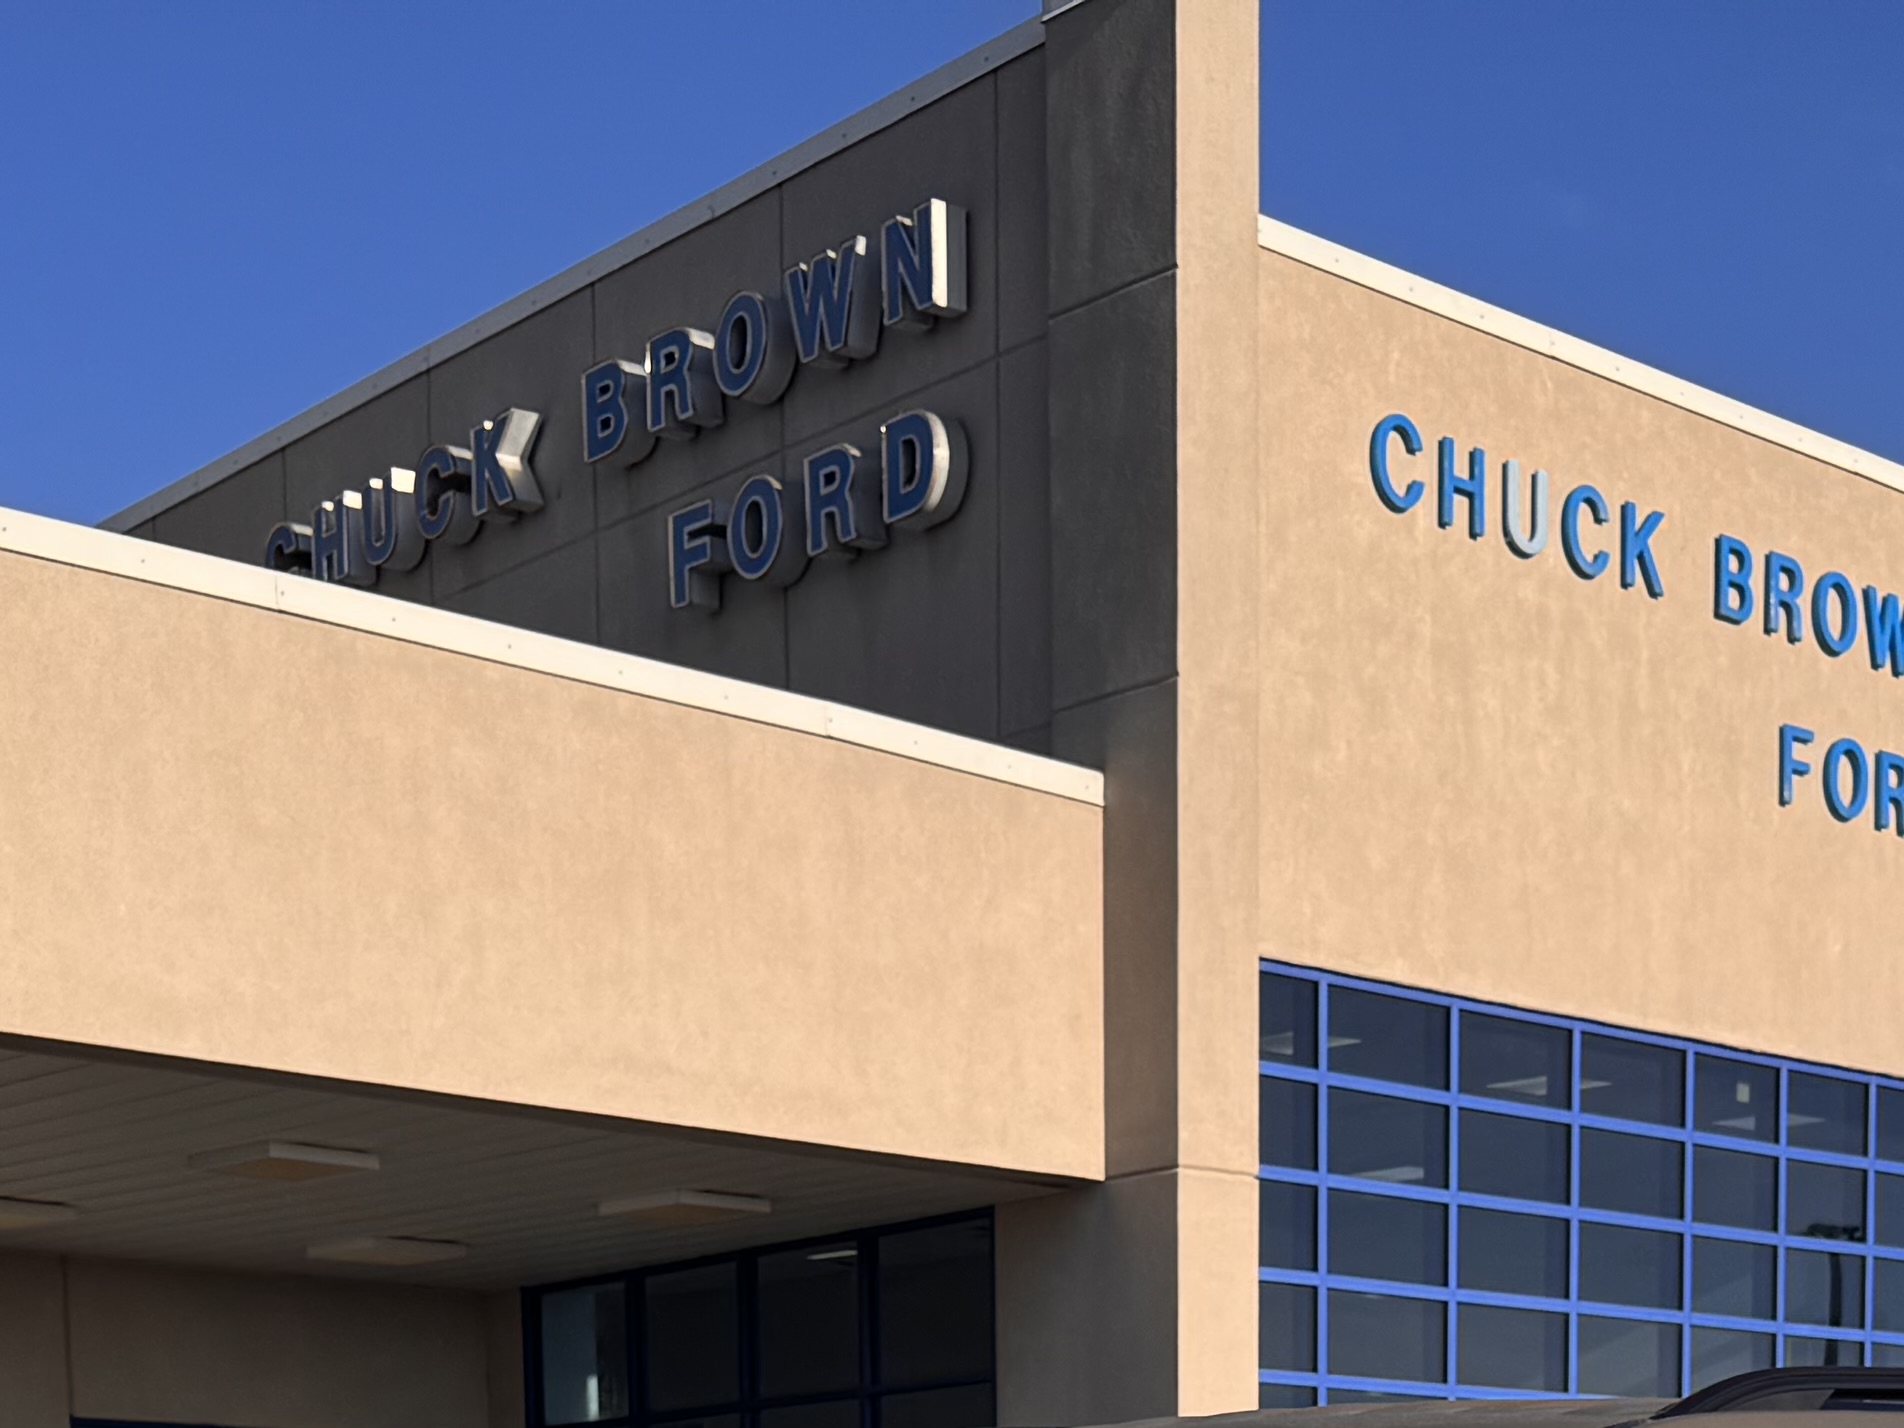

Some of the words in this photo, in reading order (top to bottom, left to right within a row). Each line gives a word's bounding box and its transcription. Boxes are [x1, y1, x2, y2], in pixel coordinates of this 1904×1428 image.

[582, 198, 967, 465] BROWN
[668, 410, 964, 610] FORD
[1369, 413, 1666, 600] CHUCK
